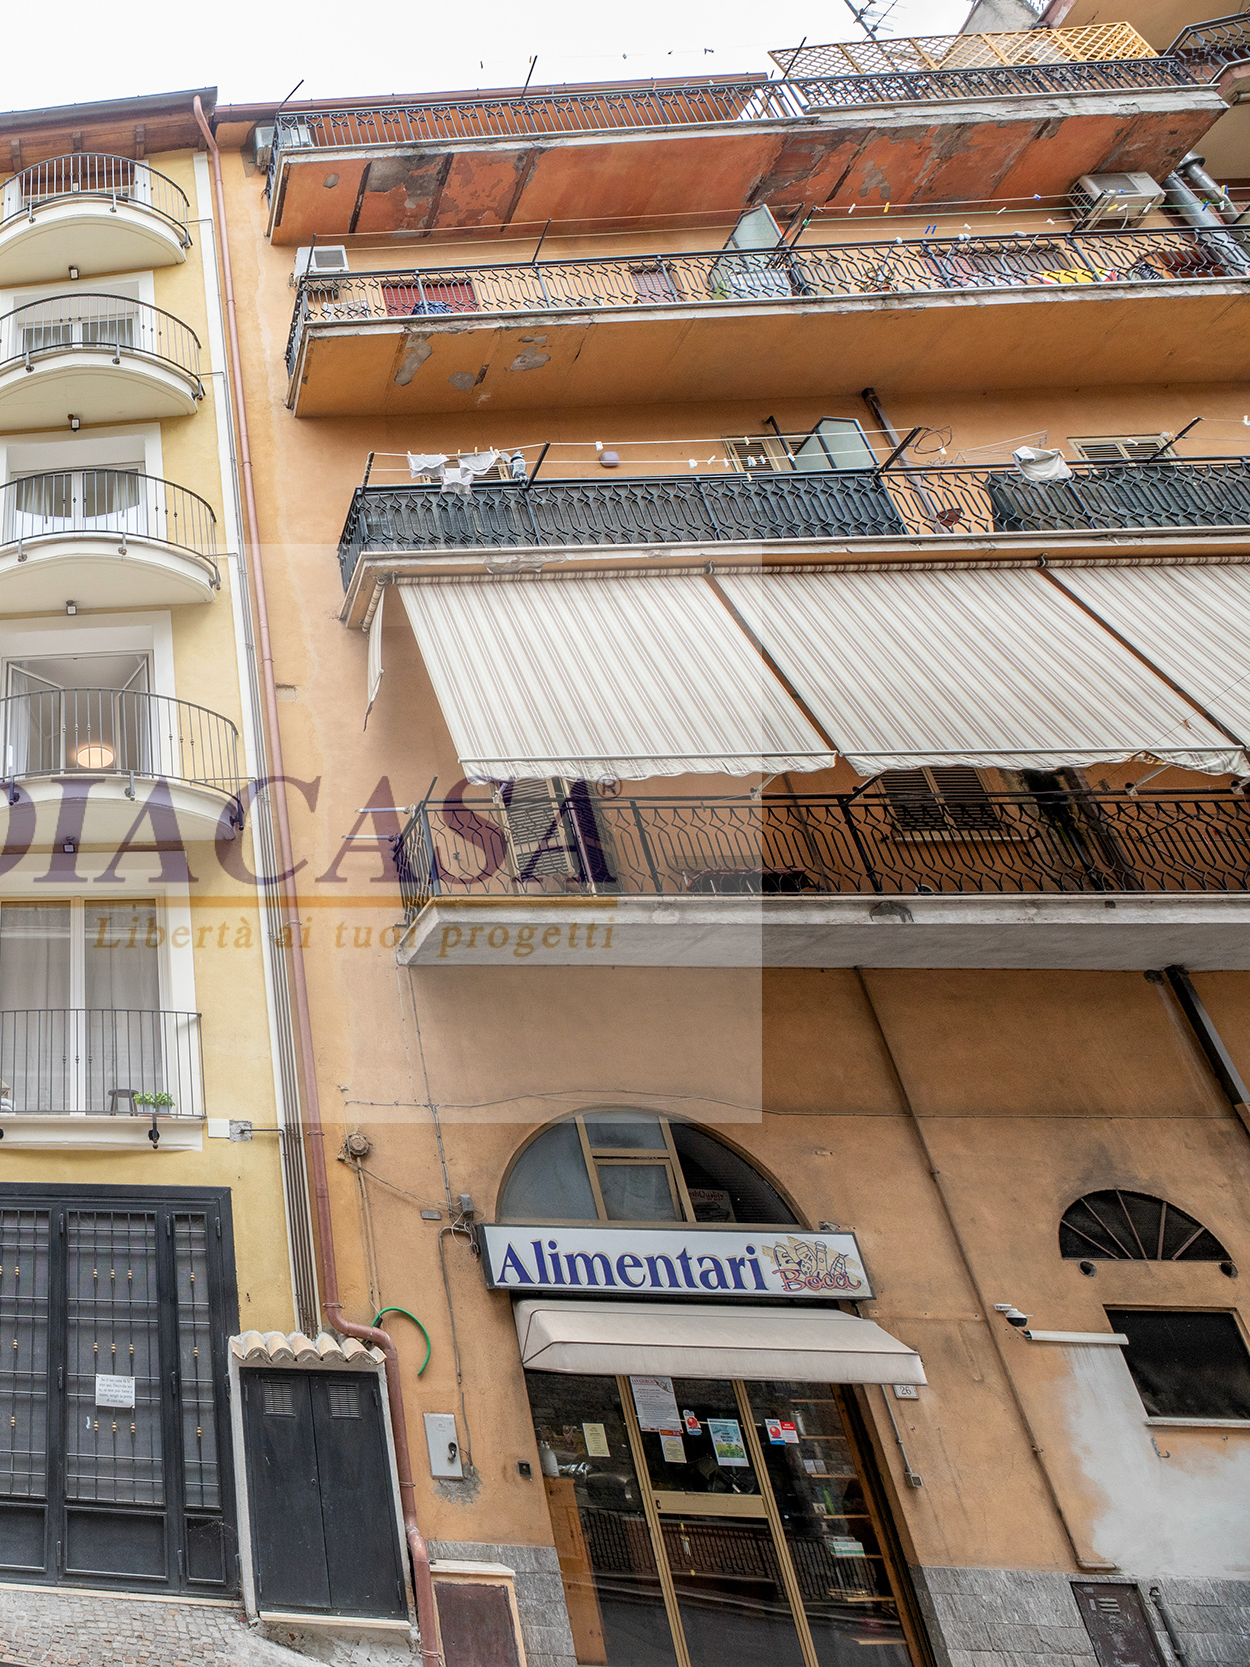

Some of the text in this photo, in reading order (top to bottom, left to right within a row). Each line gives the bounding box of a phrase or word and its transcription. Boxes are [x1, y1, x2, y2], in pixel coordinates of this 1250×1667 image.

[497, 1238, 769, 1291] Alimentari
[772, 1269, 862, 1292] Bocci
[900, 1386, 911, 1395] 26
